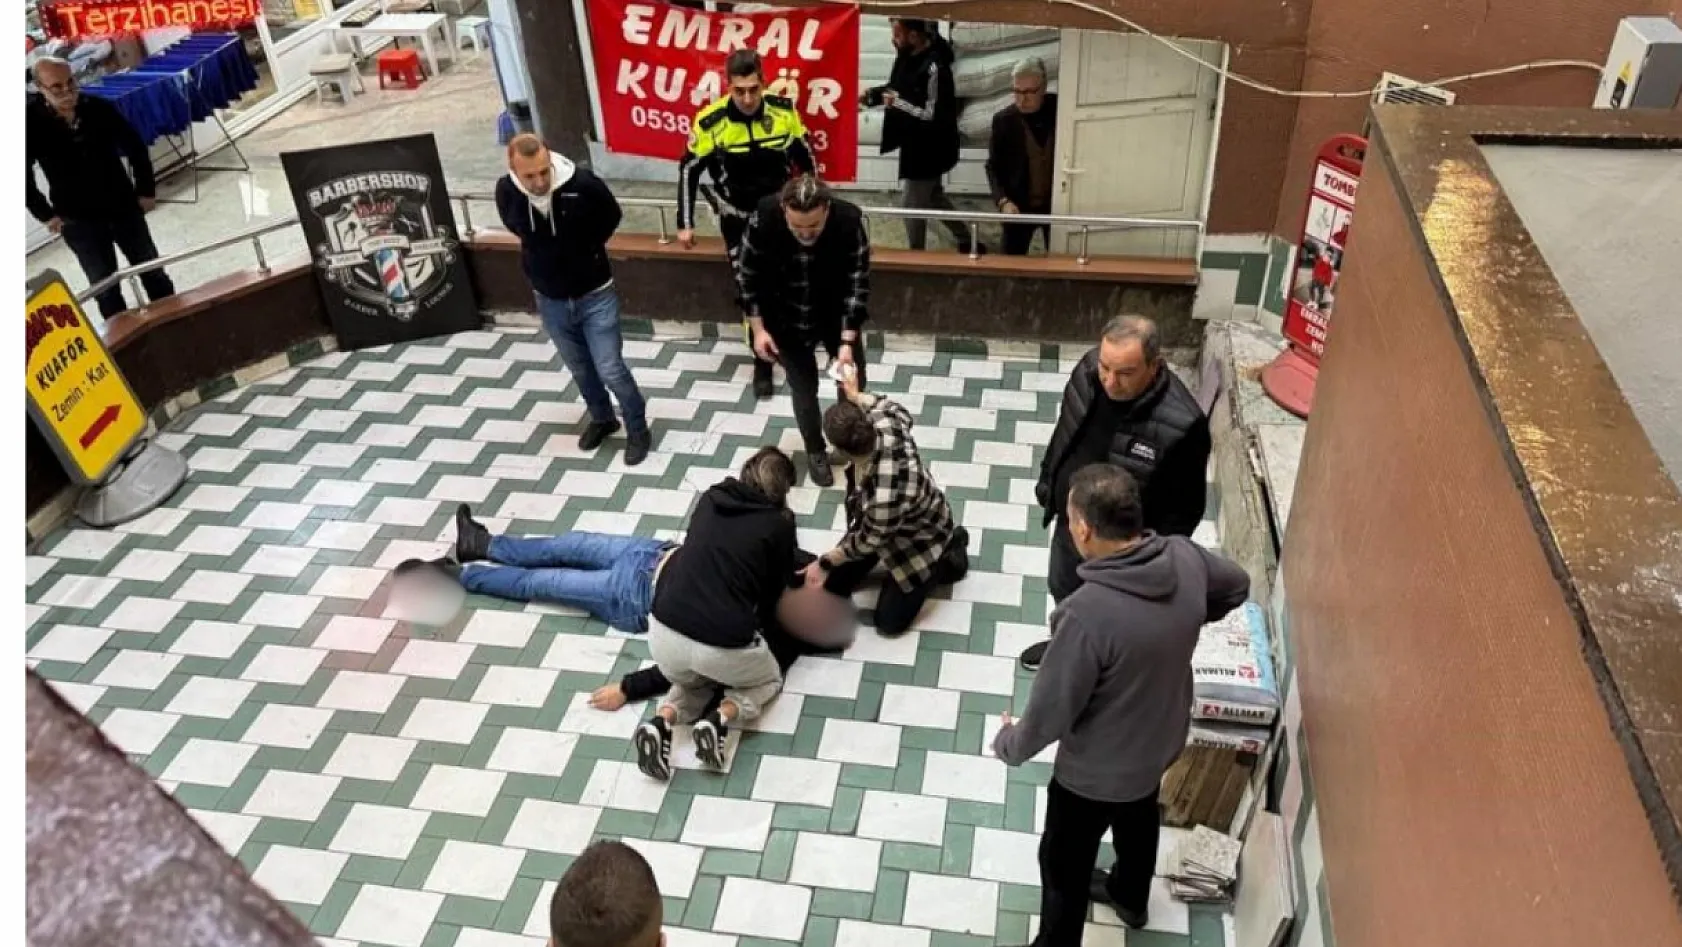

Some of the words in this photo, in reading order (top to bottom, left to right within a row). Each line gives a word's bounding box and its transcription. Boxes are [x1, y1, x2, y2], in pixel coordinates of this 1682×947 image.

[57, 0, 255, 37] Terzihanesi
[622, 4, 823, 60] EMRAL
[616, 59, 842, 119] KUAÖR
[631, 105, 690, 135] 0538
[308, 172, 429, 208] BARBERSHOP
[36, 336, 89, 390] KUAFÖR
[52, 387, 84, 422] Zemin
[86, 362, 109, 387] Kat
